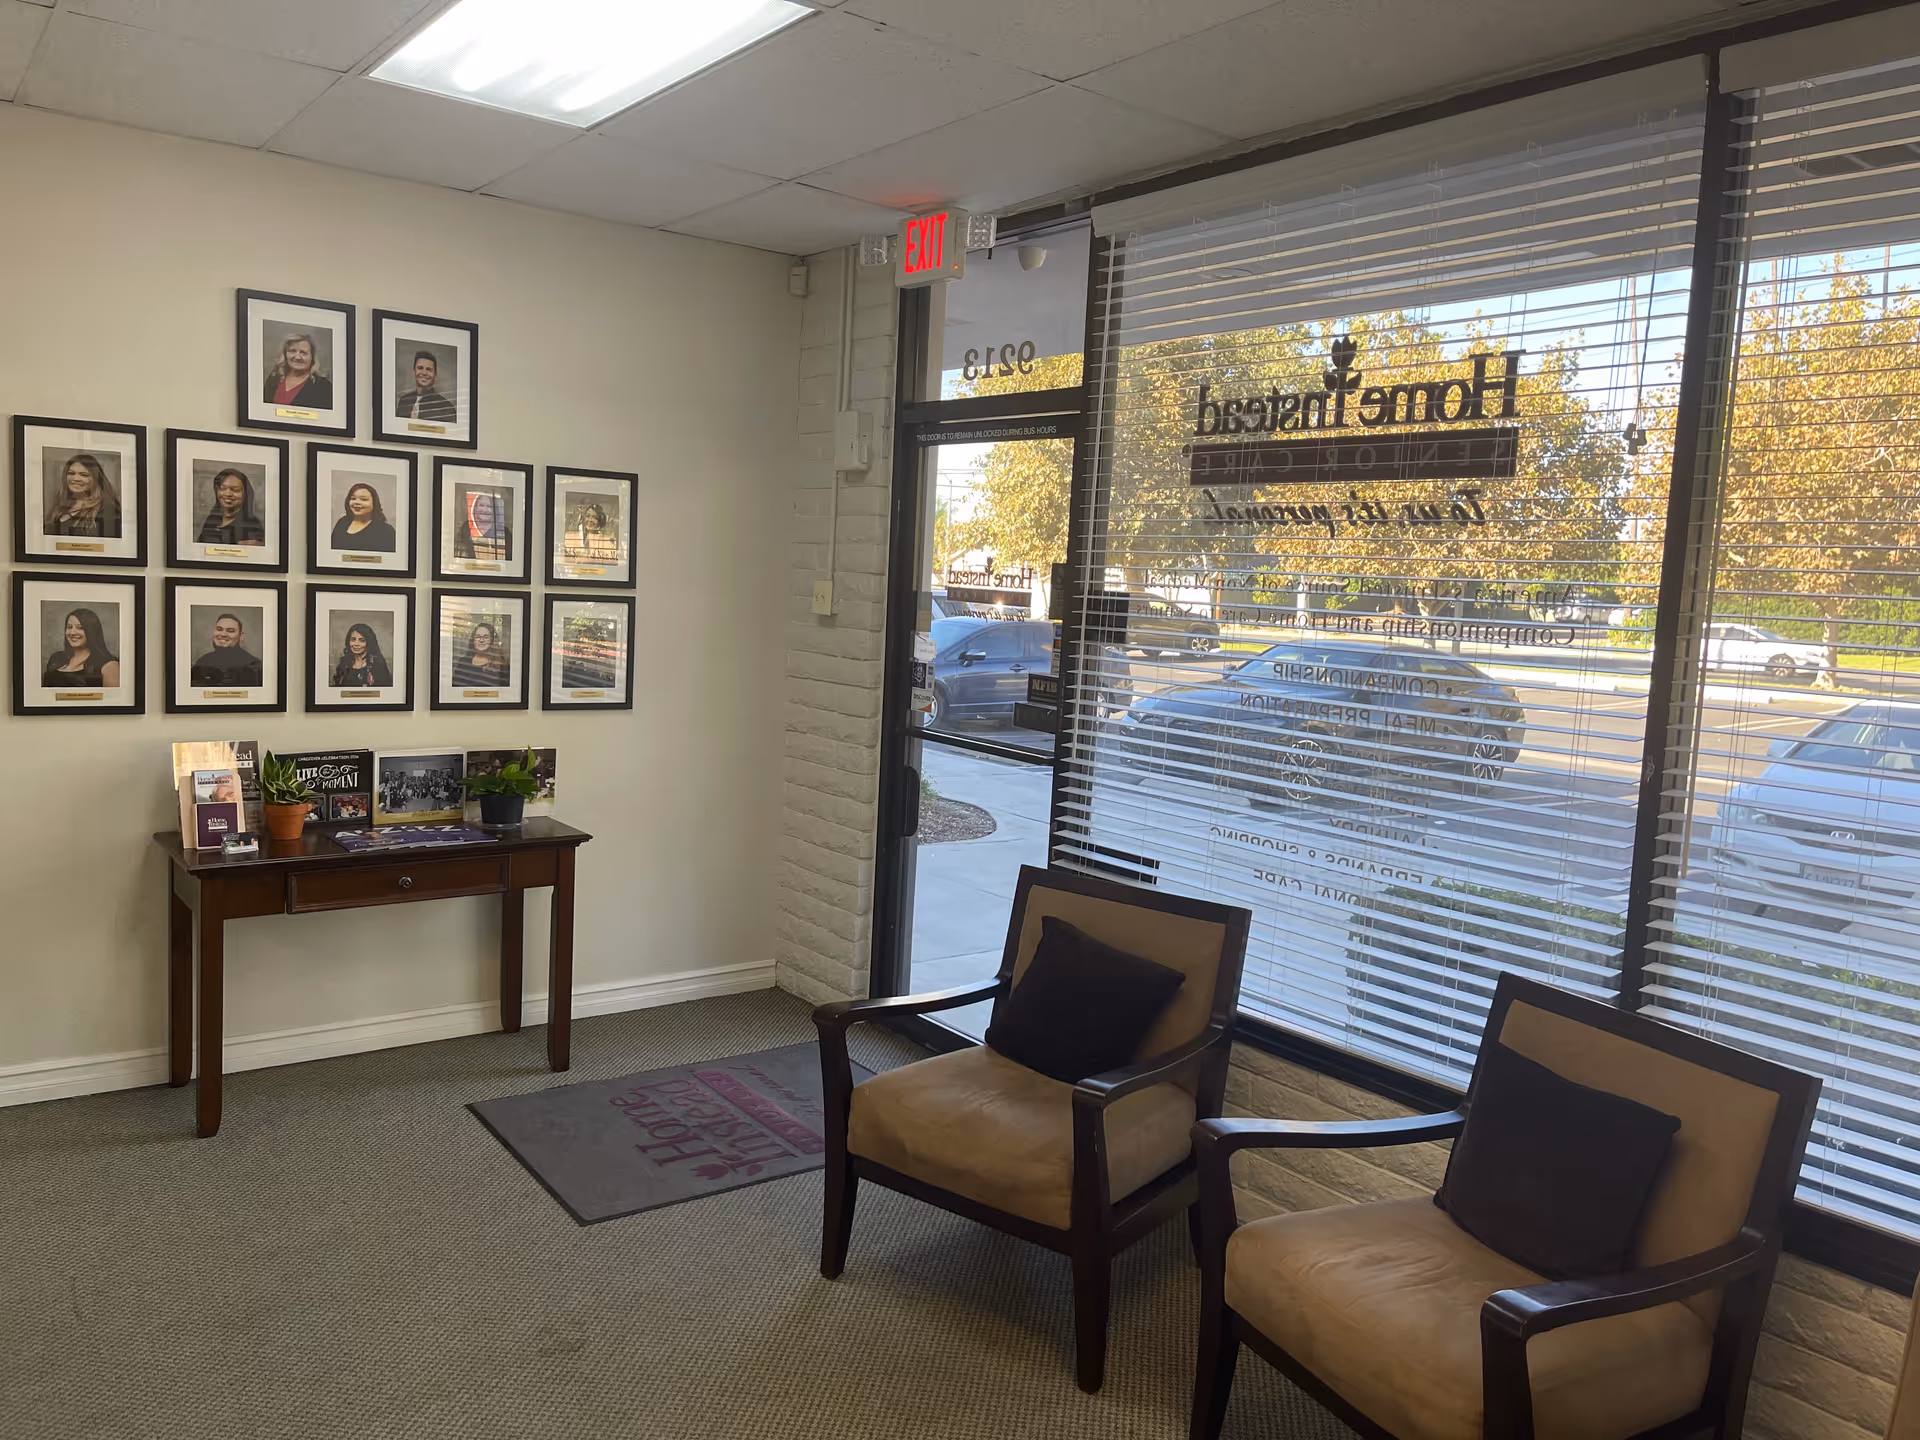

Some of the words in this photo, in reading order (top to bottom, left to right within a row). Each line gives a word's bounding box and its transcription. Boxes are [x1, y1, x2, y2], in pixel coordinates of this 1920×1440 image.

[904, 213, 948, 274] EXIT
[927, 433, 941, 441] DOOR
[954, 431, 973, 440] REMAIN
[973, 429, 1002, 439] UNLOCKED
[1002, 427, 1023, 437] DURING
[1036, 425, 1057, 434] HOURS
[296, 767, 318, 781] LIVE
[322, 772, 359, 789] MOMENT
[609, 1095, 722, 1167] Home
[628, 1079, 799, 1174] Instead
